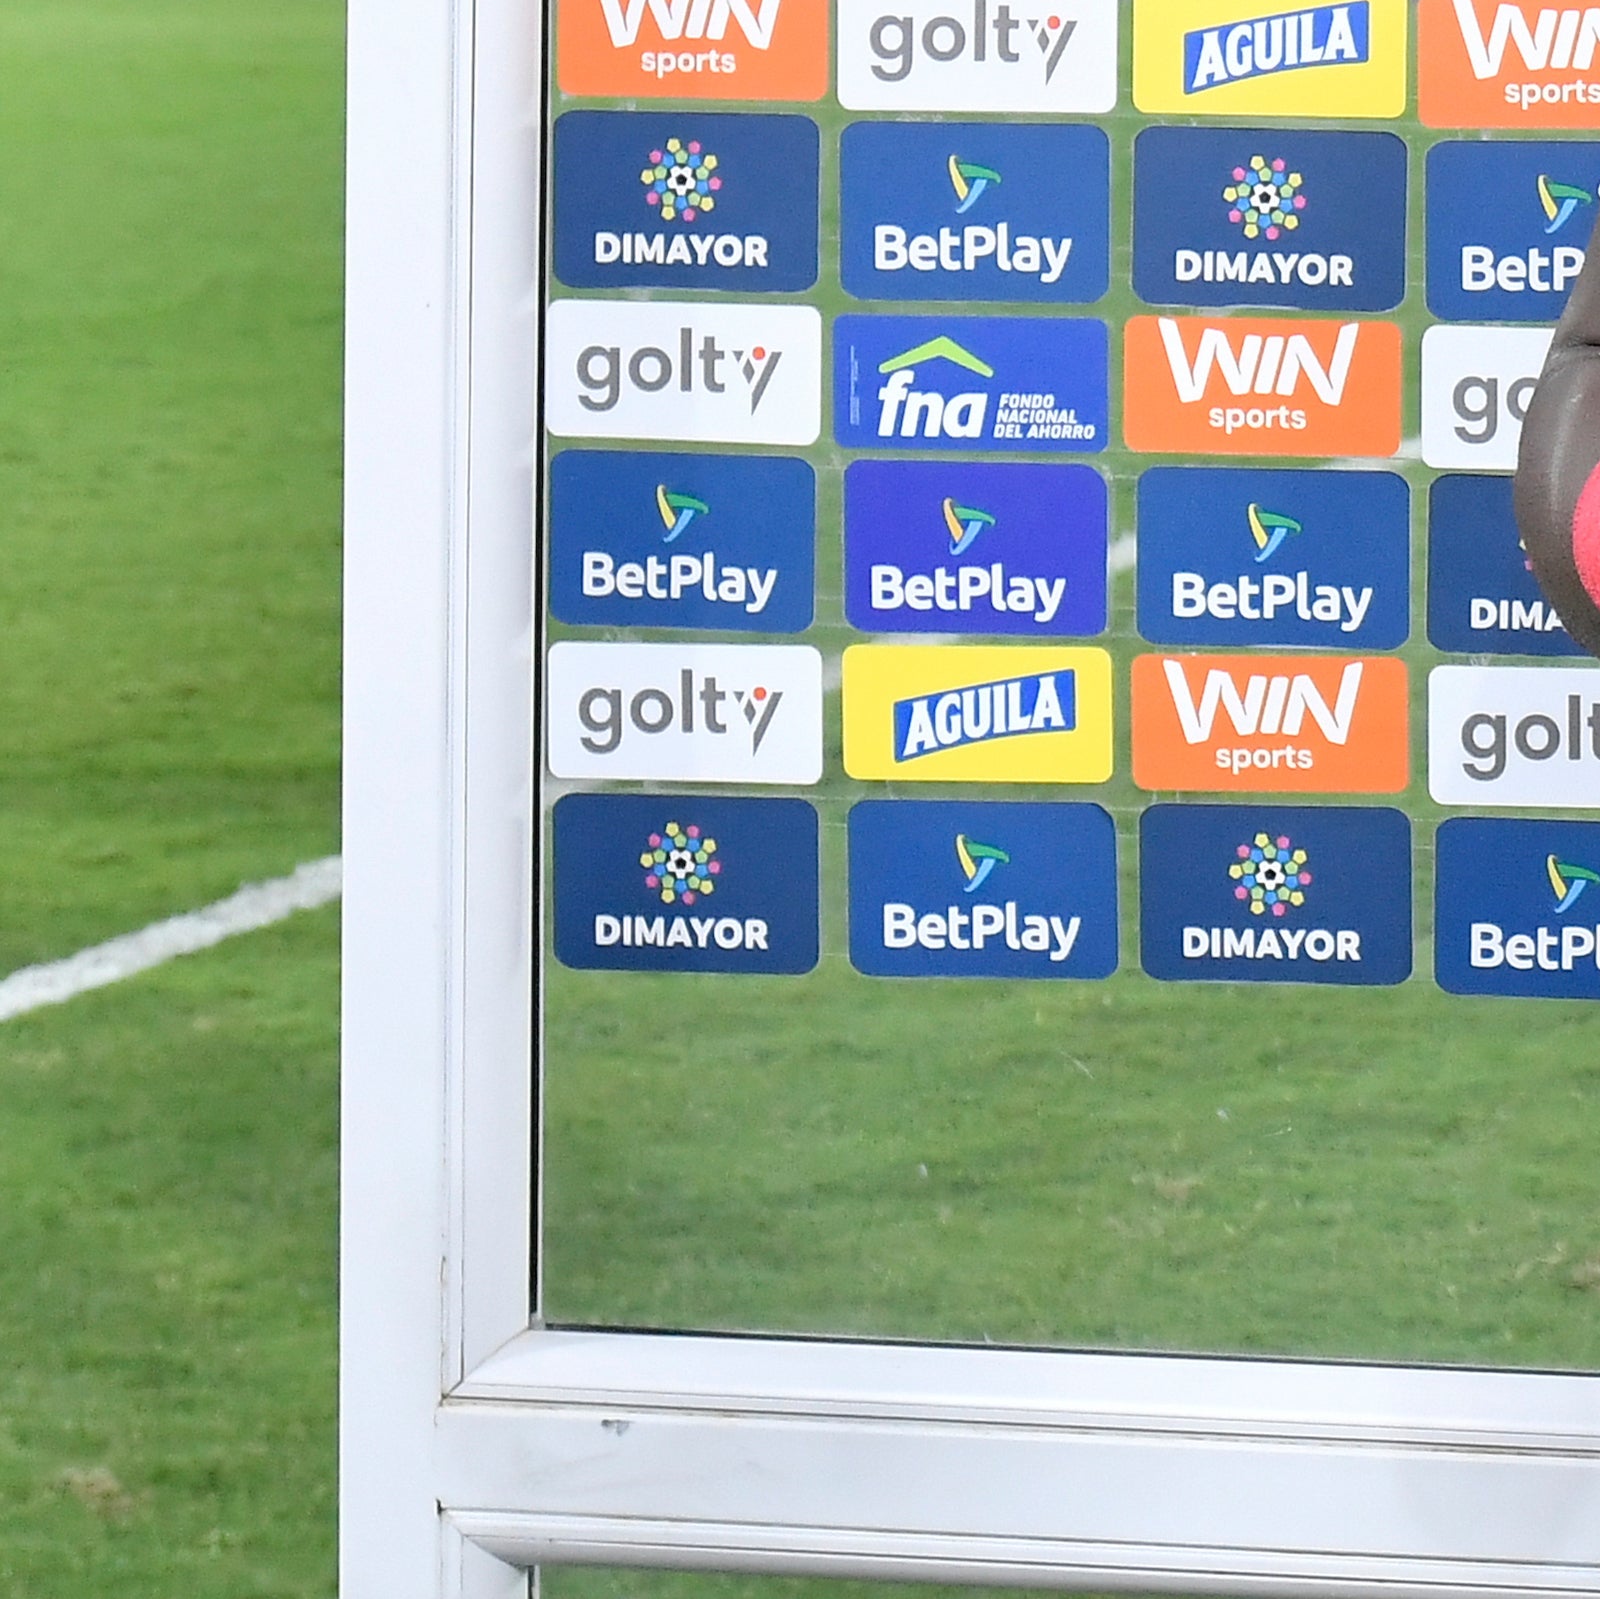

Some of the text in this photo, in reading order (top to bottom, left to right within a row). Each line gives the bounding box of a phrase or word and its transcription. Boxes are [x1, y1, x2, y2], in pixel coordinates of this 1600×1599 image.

[642, 50, 736, 78] sports
[1192, 8, 1358, 89] AGUILA
[596, 233, 767, 266] DIMAYOR
[875, 223, 1072, 282] BetPlay
[1176, 250, 1353, 285] DIMAYOR
[1461, 246, 1585, 291] BetP
[577, 328, 782, 415] golty
[1159, 317, 1358, 405] WIN
[879, 370, 987, 437] fna
[996, 409, 1076, 424] NACIONAL
[998, 395, 1054, 409] FONDO
[1210, 406, 1306, 434] sports
[993, 424, 1095, 440] DEL AHORRO
[583, 552, 777, 612] BetPlay
[872, 563, 1065, 622] BetPlay
[1173, 572, 1372, 631] BetPlay
[1470, 598, 1568, 632] DIMA
[579, 669, 783, 755] golty
[901, 675, 1066, 758] AGUILA
[1163, 659, 1363, 744] WIN
[1216, 745, 1313, 774] sports
[596, 915, 768, 949] DIMAYOR
[884, 902, 1080, 960] BetPlay
[1184, 927, 1360, 960] DIMAYOR
